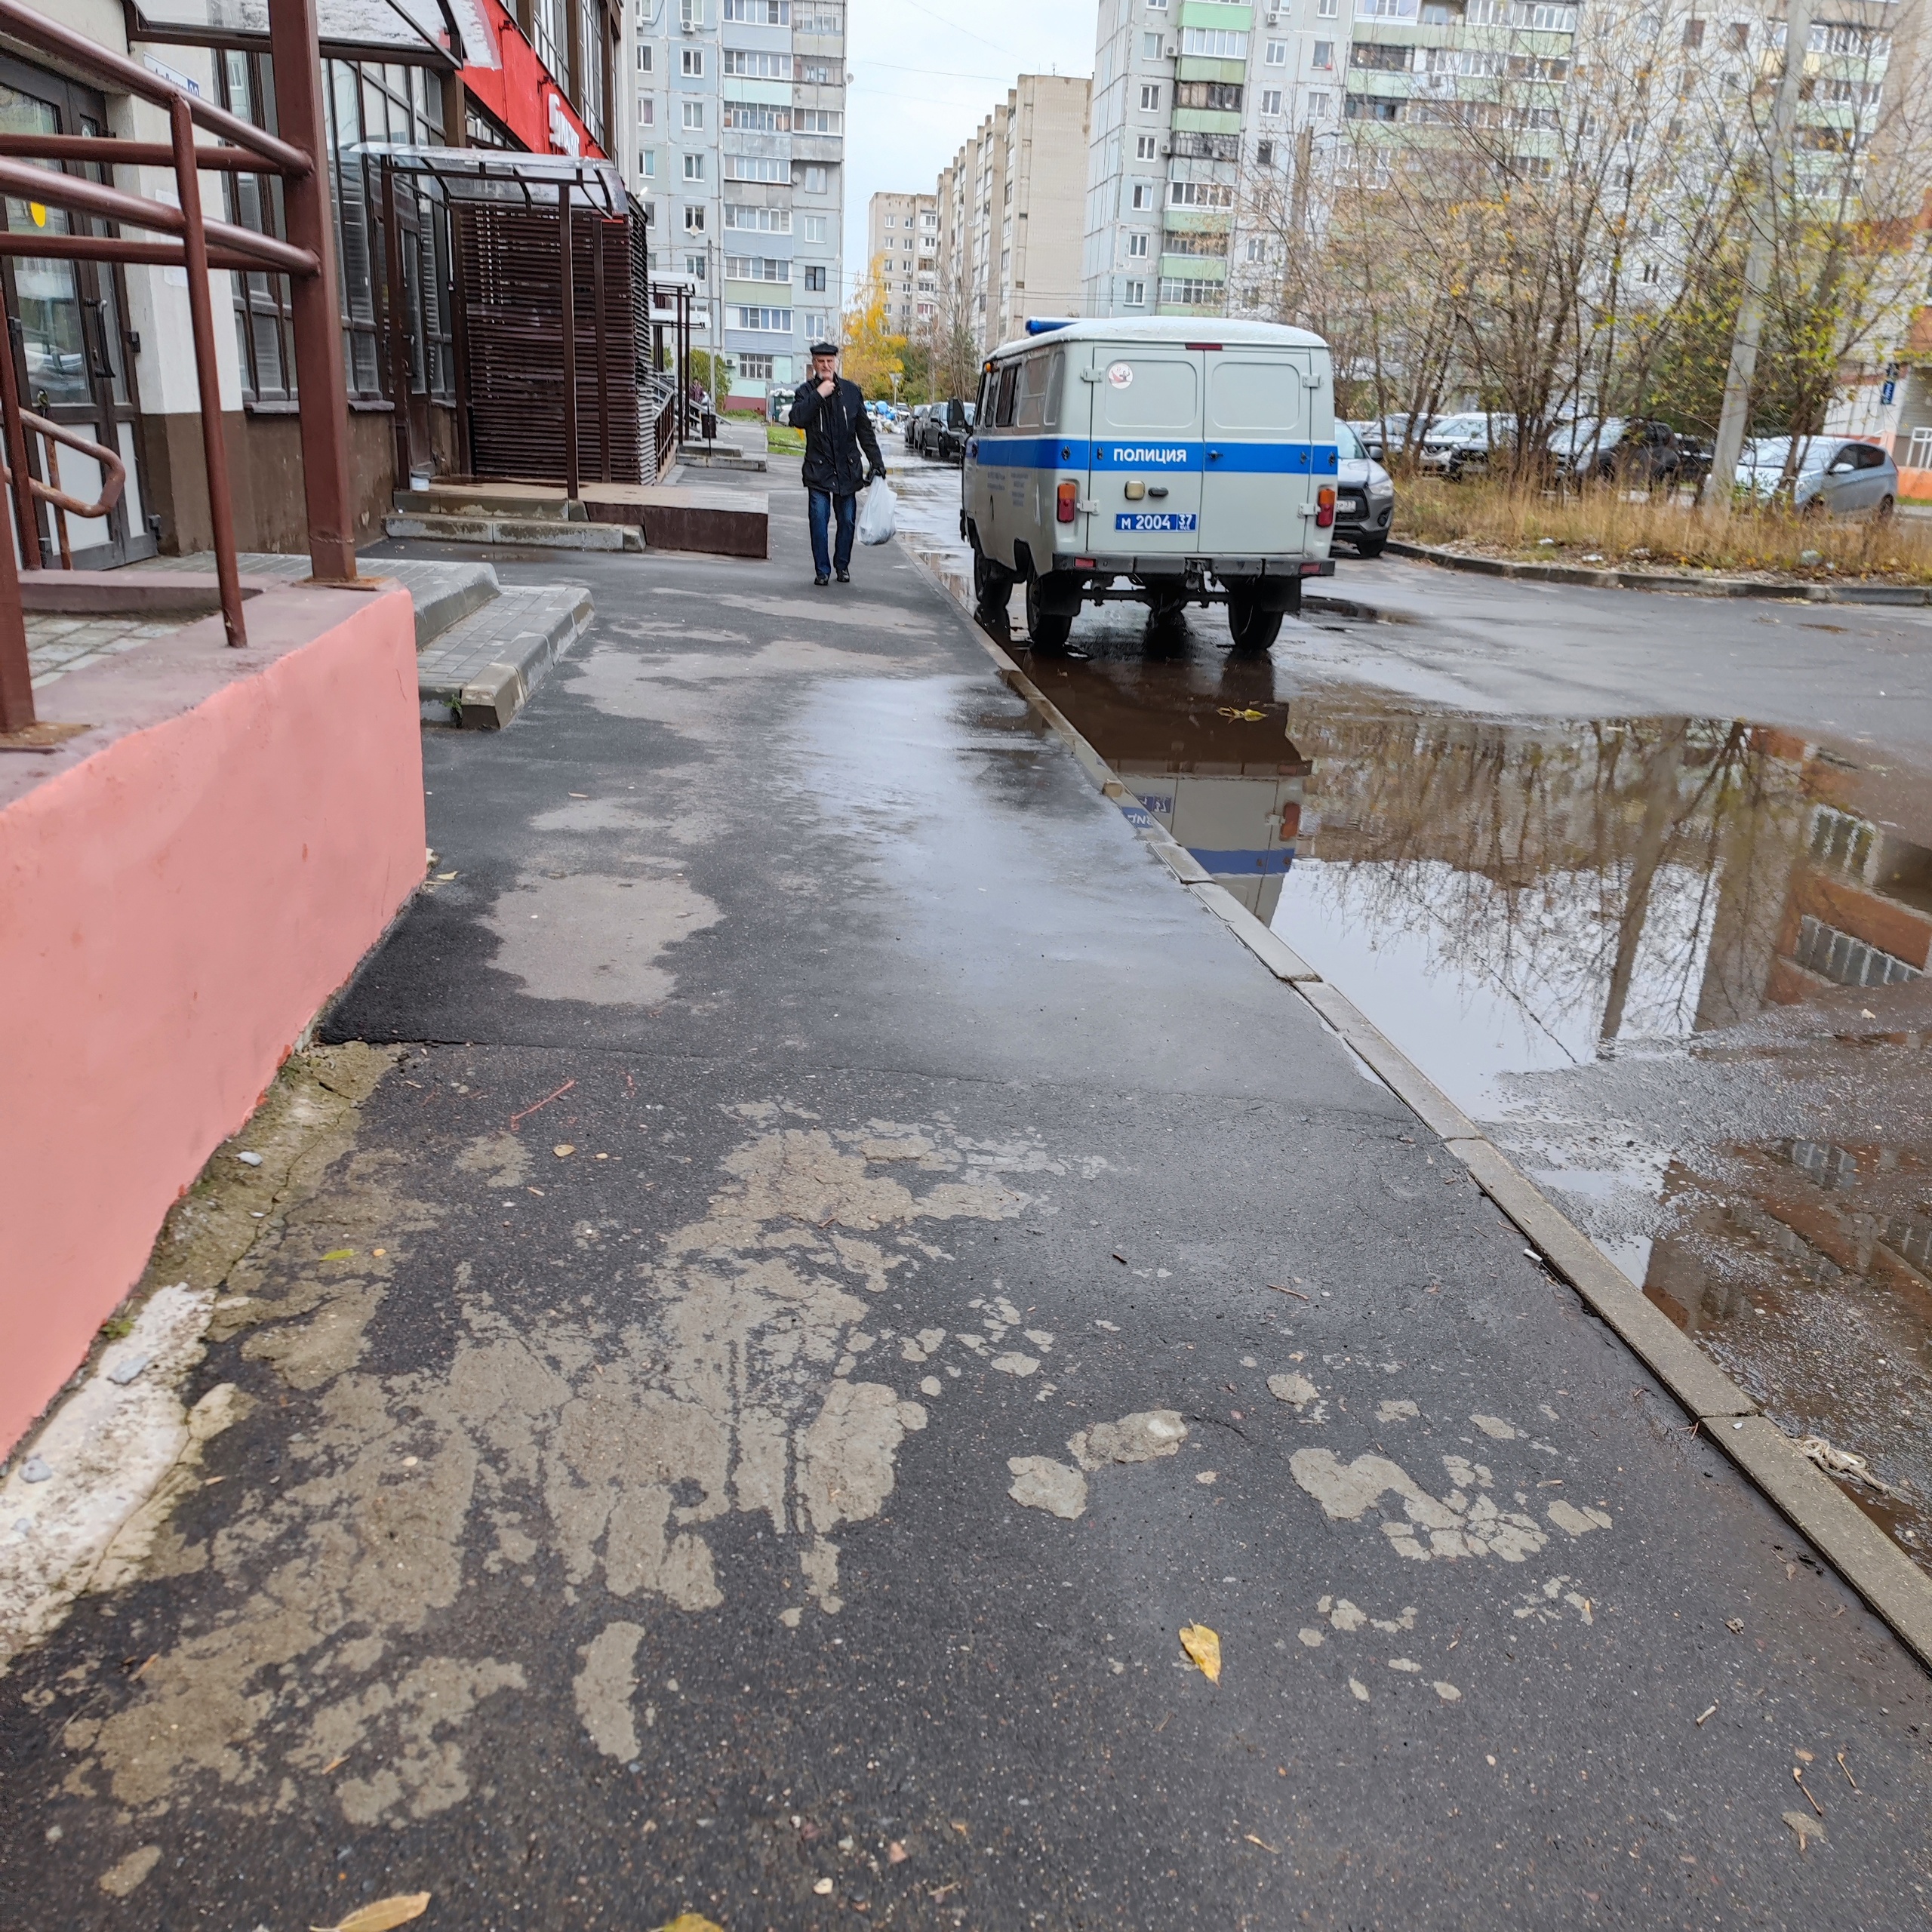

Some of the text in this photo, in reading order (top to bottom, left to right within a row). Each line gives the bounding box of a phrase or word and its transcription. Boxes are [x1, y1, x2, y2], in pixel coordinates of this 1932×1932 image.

[1113, 448, 1187, 465] ПОЛИЦИЯ
[1135, 515, 1171, 530] 2004
[1178, 514, 1192, 527] 37
